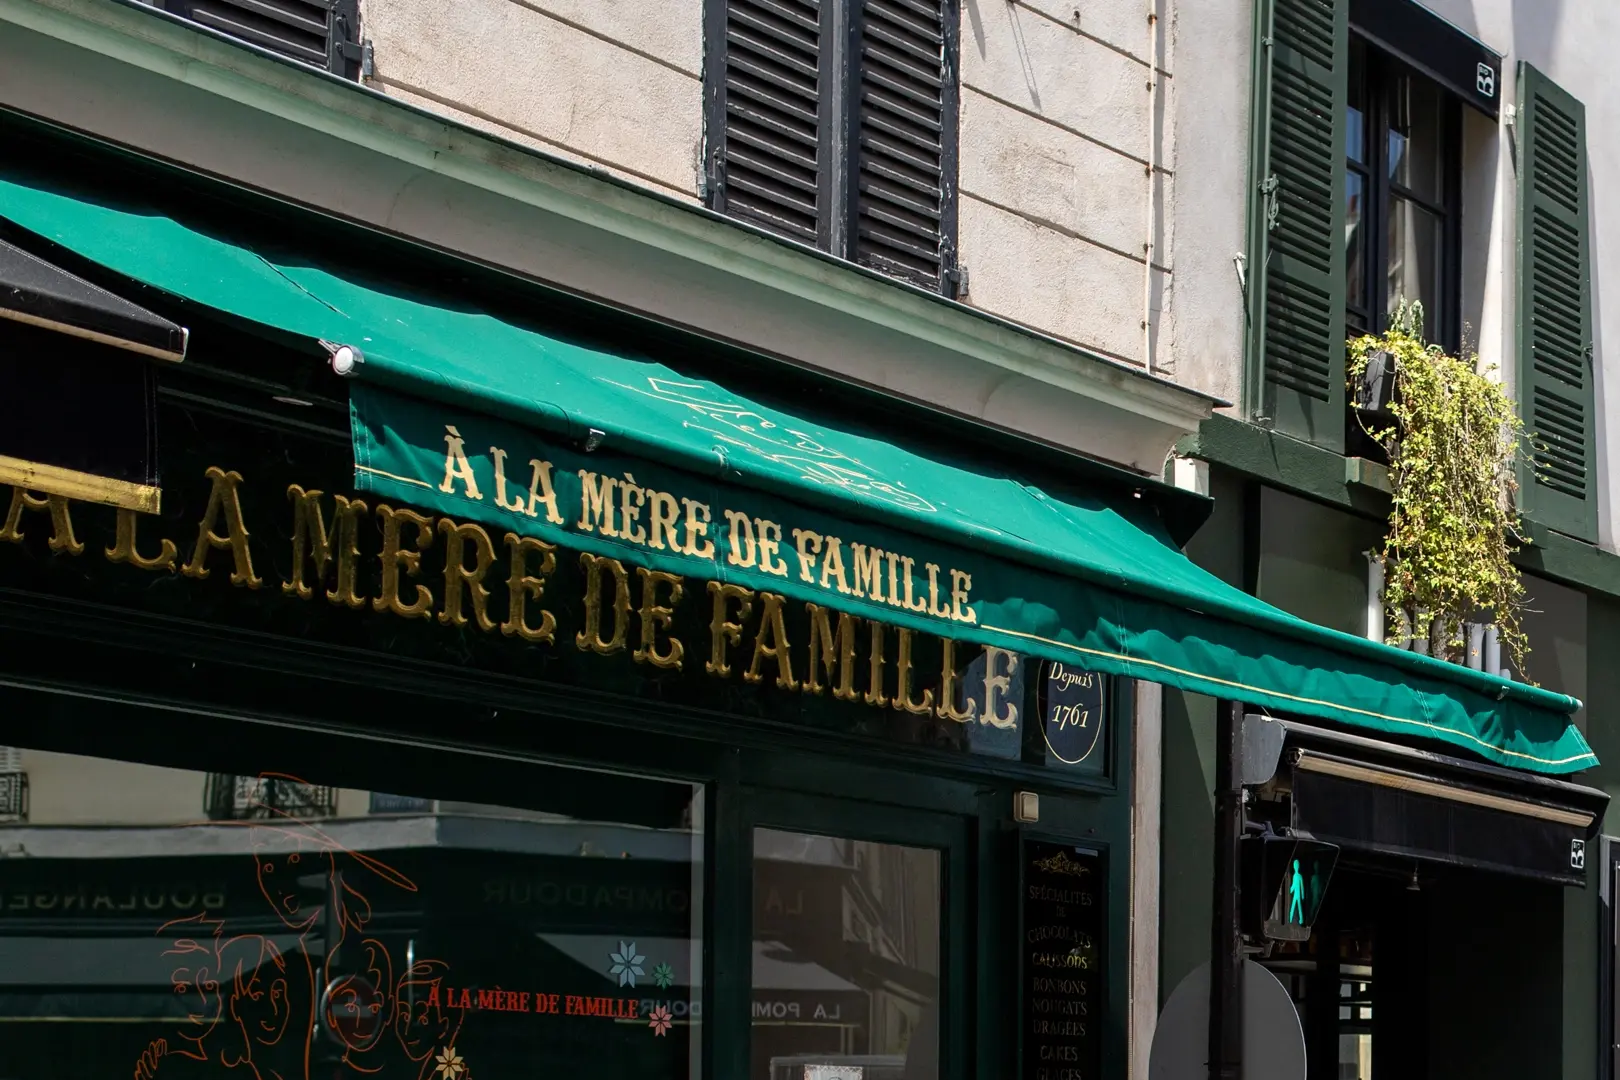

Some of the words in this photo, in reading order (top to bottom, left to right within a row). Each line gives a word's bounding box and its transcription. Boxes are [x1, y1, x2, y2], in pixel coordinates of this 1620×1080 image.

[440, 423, 483, 500] À
[489, 445, 563, 526] LA
[577, 466, 714, 559] MÈRE
[724, 508, 788, 578] DE
[792, 527, 978, 625] FAMILLE
[104, 465, 263, 590] LA
[575, 553, 685, 673] DE
[706, 581, 1020, 731] FAMILLE
[1050, 662, 1093, 690] Depuis
[1052, 704, 1089, 732] 1761
[1032, 976, 1088, 996] BONBONS
[446, 988, 471, 1010] LA
[535, 992, 561, 1015] DE
[564, 995, 640, 1020] FAMILLE
[1039, 1045, 1079, 1062] CAKES
